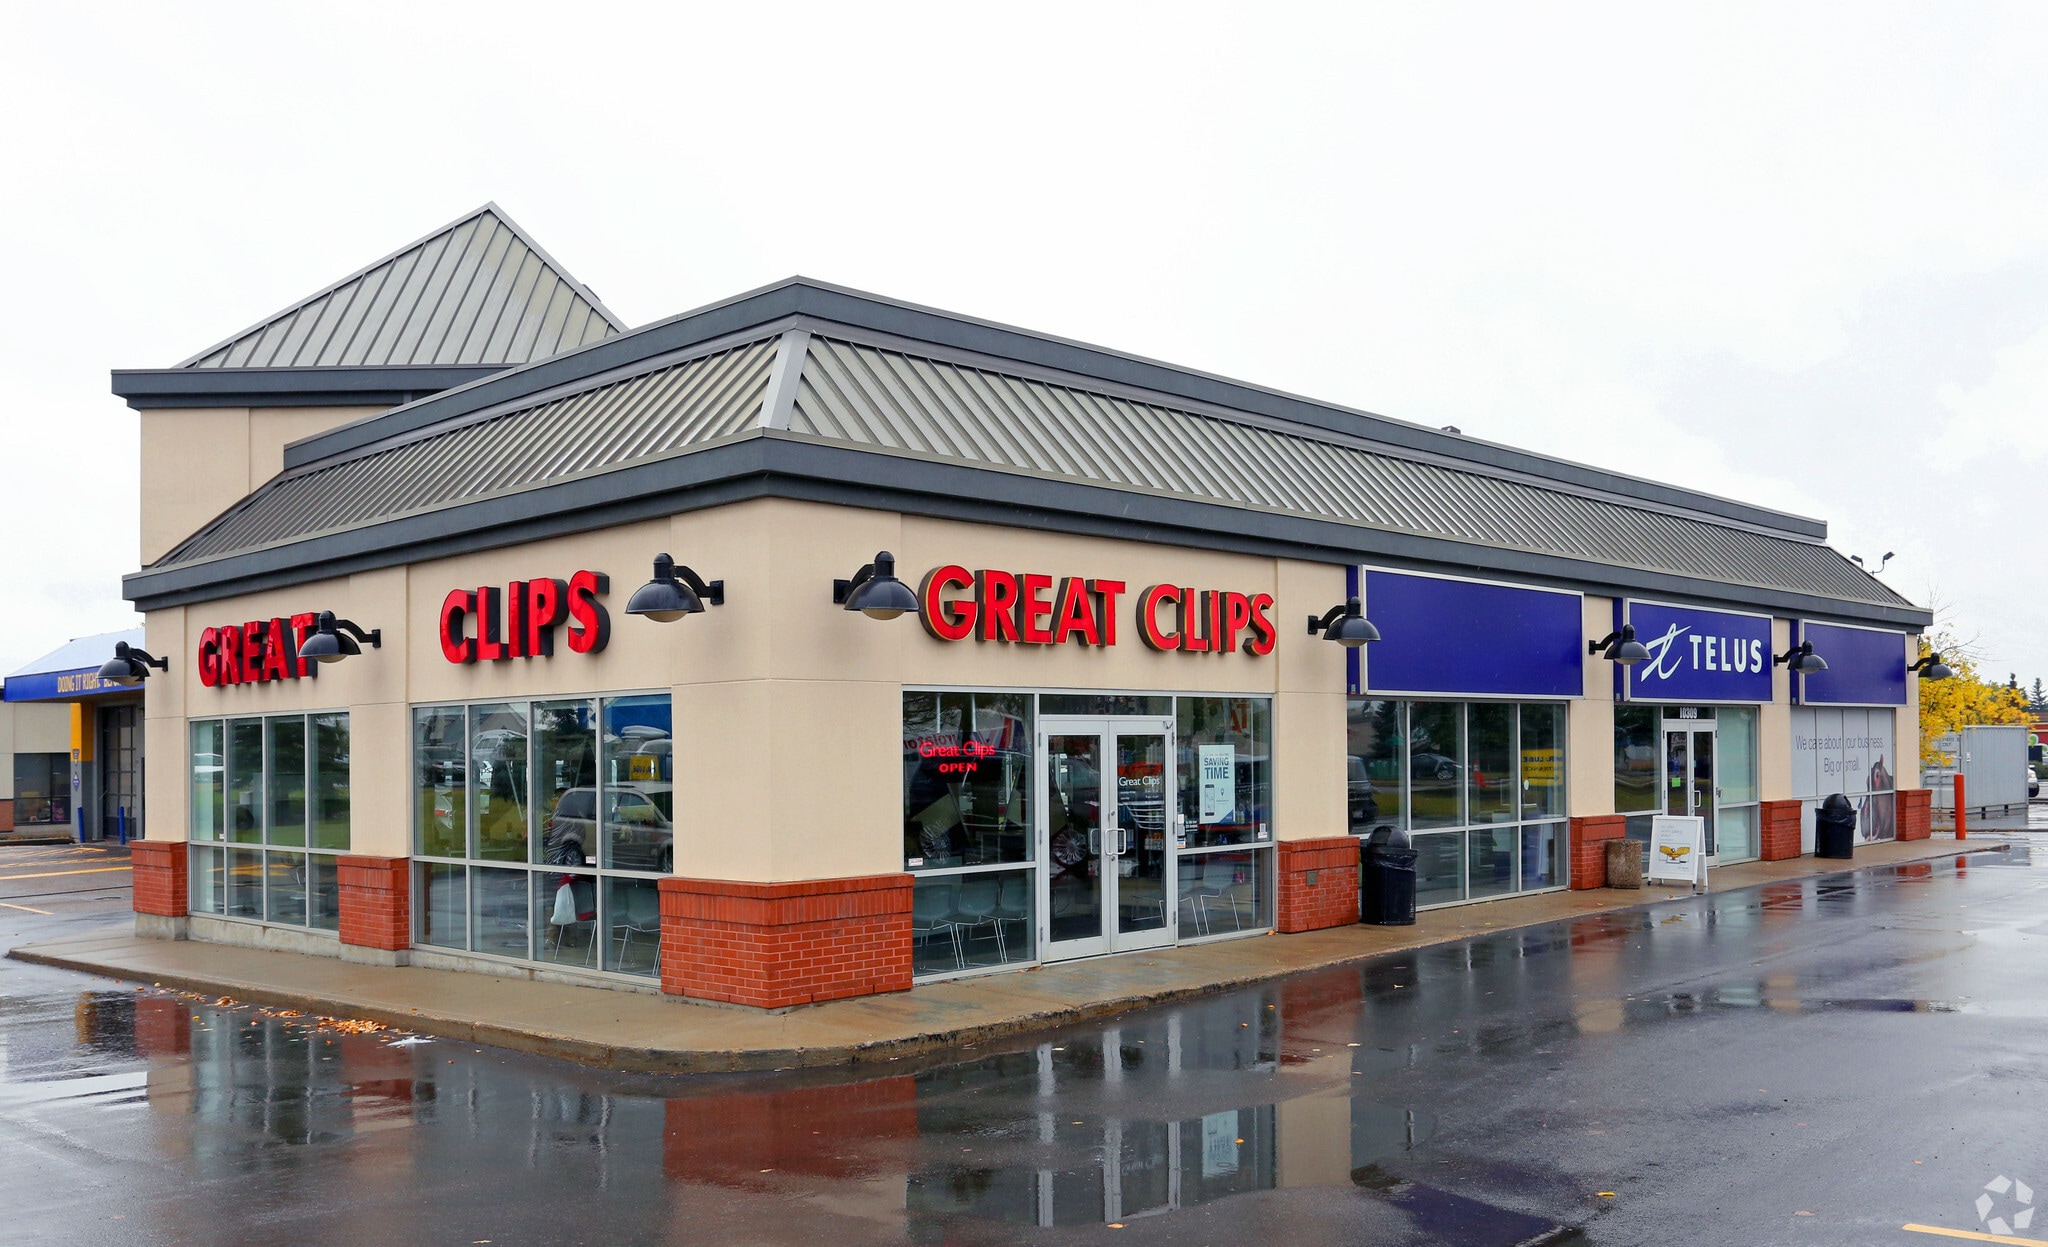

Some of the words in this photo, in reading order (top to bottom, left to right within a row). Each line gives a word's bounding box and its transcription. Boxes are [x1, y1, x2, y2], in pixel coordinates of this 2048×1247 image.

[439, 570, 611, 664] CLIPS
[918, 565, 1125, 647] GREAT
[1136, 584, 1276, 656] CLIPS
[198, 612, 317, 687] GREAT
[1689, 635, 1762, 674] TELUS
[57, 675, 75, 693] DOING
[75, 674, 82, 691] IT
[1680, 707, 1697, 719] 10309
[920, 741, 960, 758] Great
[963, 740, 996, 759] Clips
[1795, 735, 1807, 750] We
[1808, 738, 1823, 750] cae
[1824, 734, 1842, 750] about
[1858, 734, 1885, 749] busness.
[939, 762, 978, 774] OPEN
[1204, 757, 1229, 767] SAVING
[1823, 757, 1834, 776] Big
[1835, 761, 1842, 773] or
[1118, 776, 1141, 787] Great
[1142, 775, 1160, 788] Clips
[1205, 767, 1229, 780] TIME
